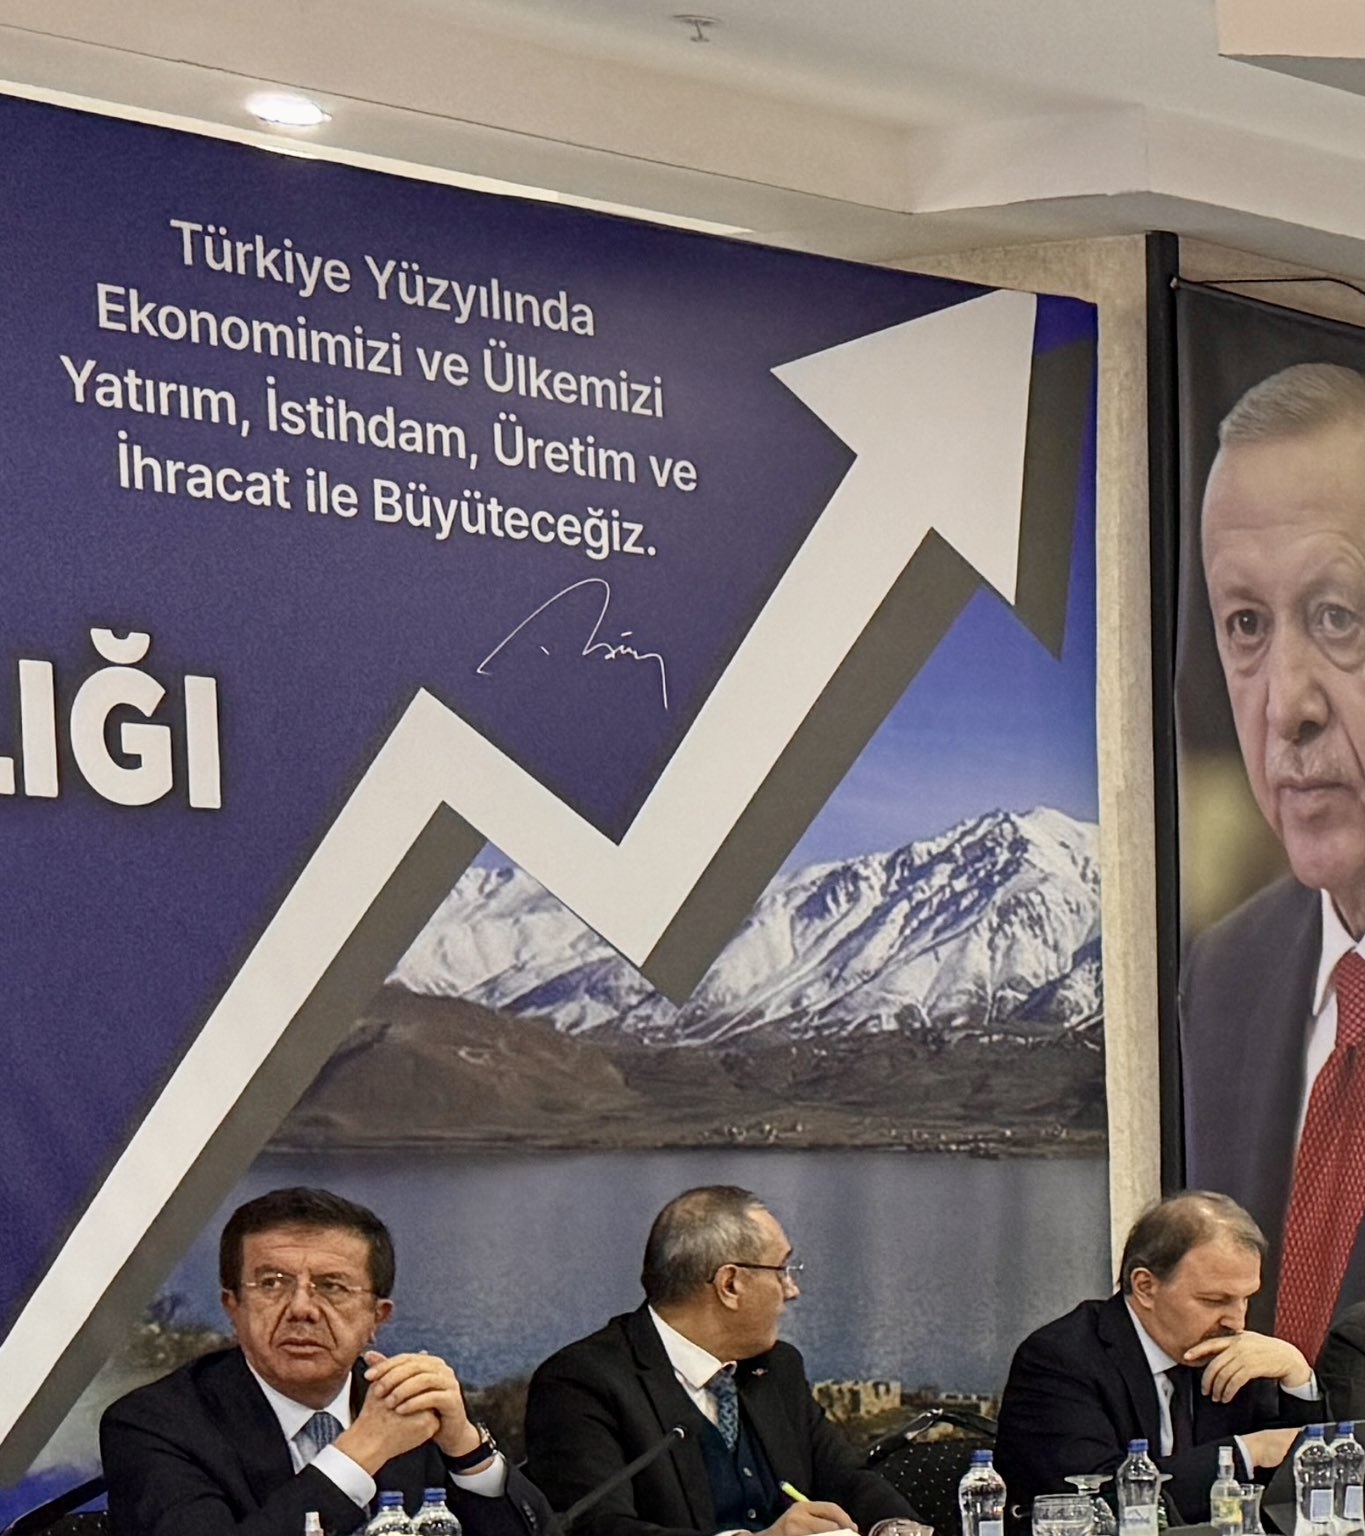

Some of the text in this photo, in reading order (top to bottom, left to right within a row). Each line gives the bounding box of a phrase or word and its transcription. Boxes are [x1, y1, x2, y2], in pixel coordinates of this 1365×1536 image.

[170, 219, 596, 336] Türkiye Yüzyılında
[97, 282, 664, 418] Ekonomimizi ve Ülkemizi
[60, 355, 698, 492] Yatırım, İstihdam, Üretim ve
[118, 431, 657, 560] İhracat ile Büyüteceğiz.
[0, 628, 221, 808] IĞI
